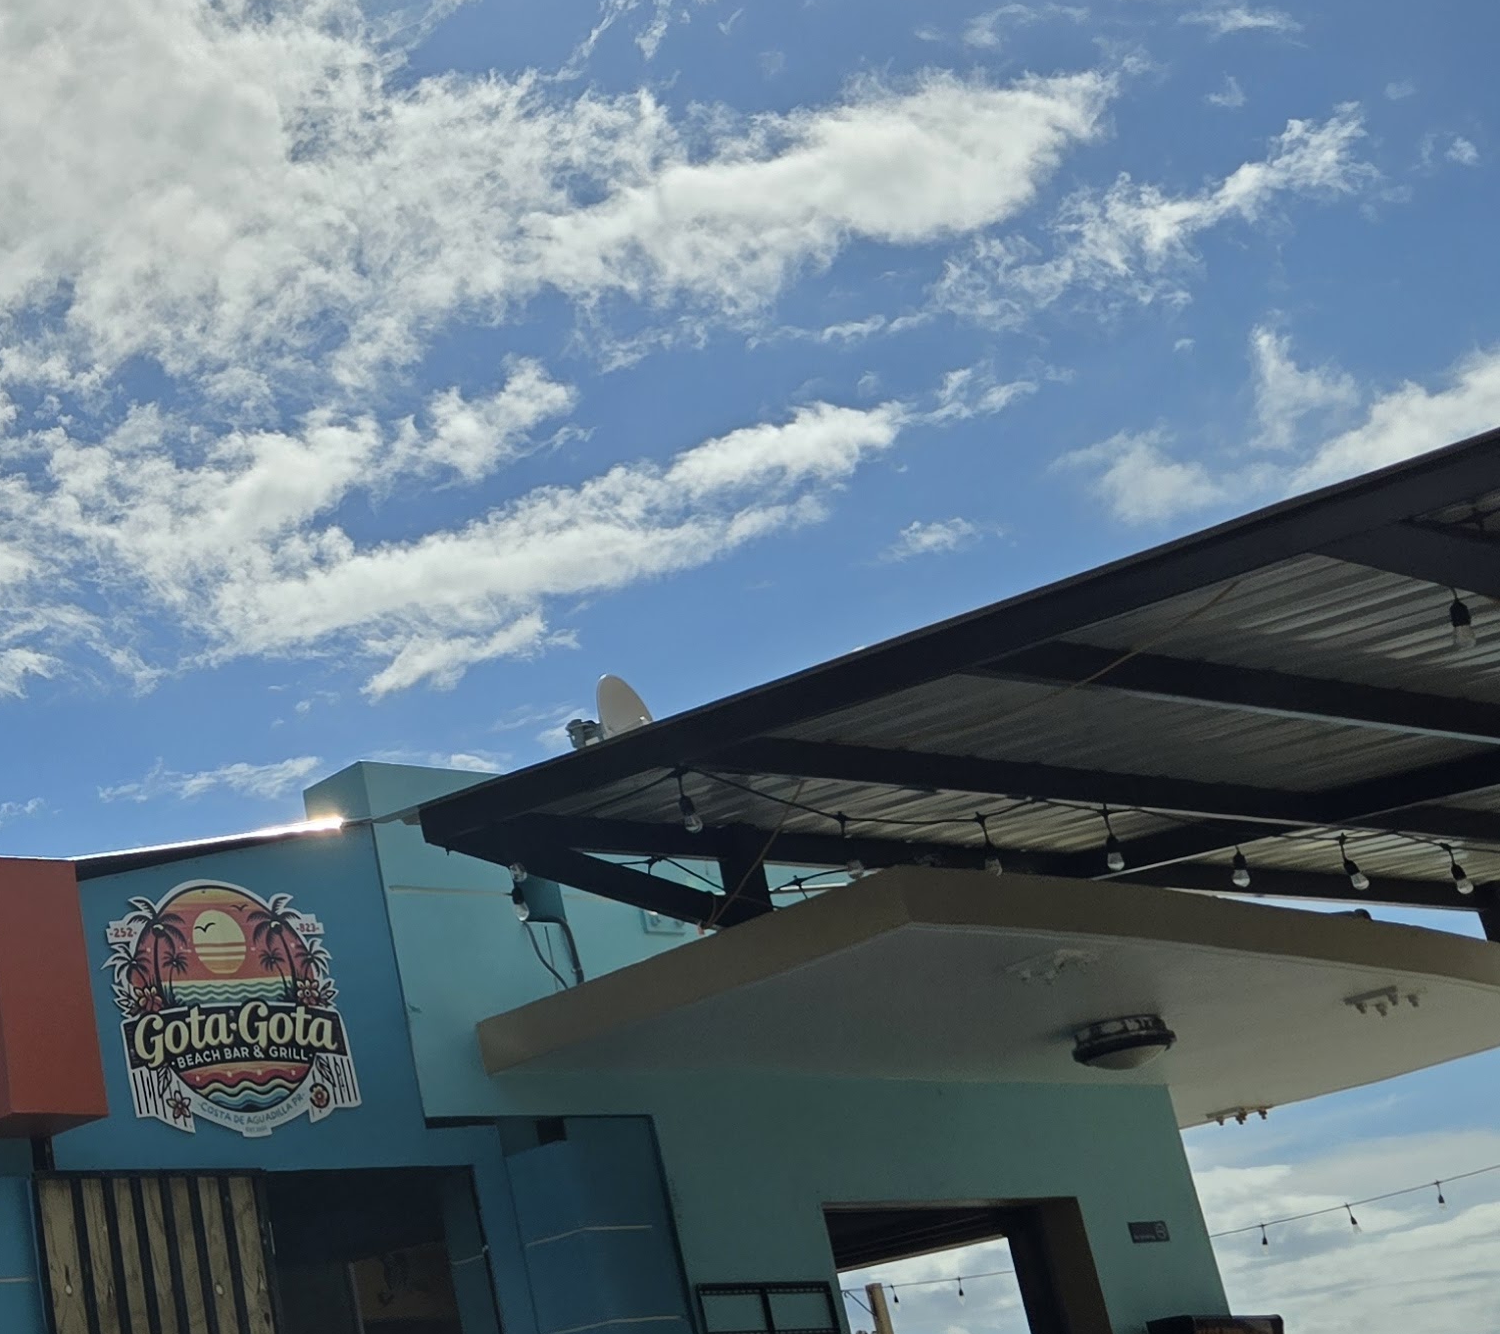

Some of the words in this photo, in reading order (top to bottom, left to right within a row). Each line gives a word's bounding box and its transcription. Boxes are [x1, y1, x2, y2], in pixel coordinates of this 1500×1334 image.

[177, 1049, 220, 1069] BEACH
[224, 1047, 249, 1059] BAR
[253, 1044, 265, 1058] &
[269, 1046, 308, 1061] GRILL
[234, 1116, 245, 1125] DE
[246, 1104, 293, 1125] AGUADILLA
